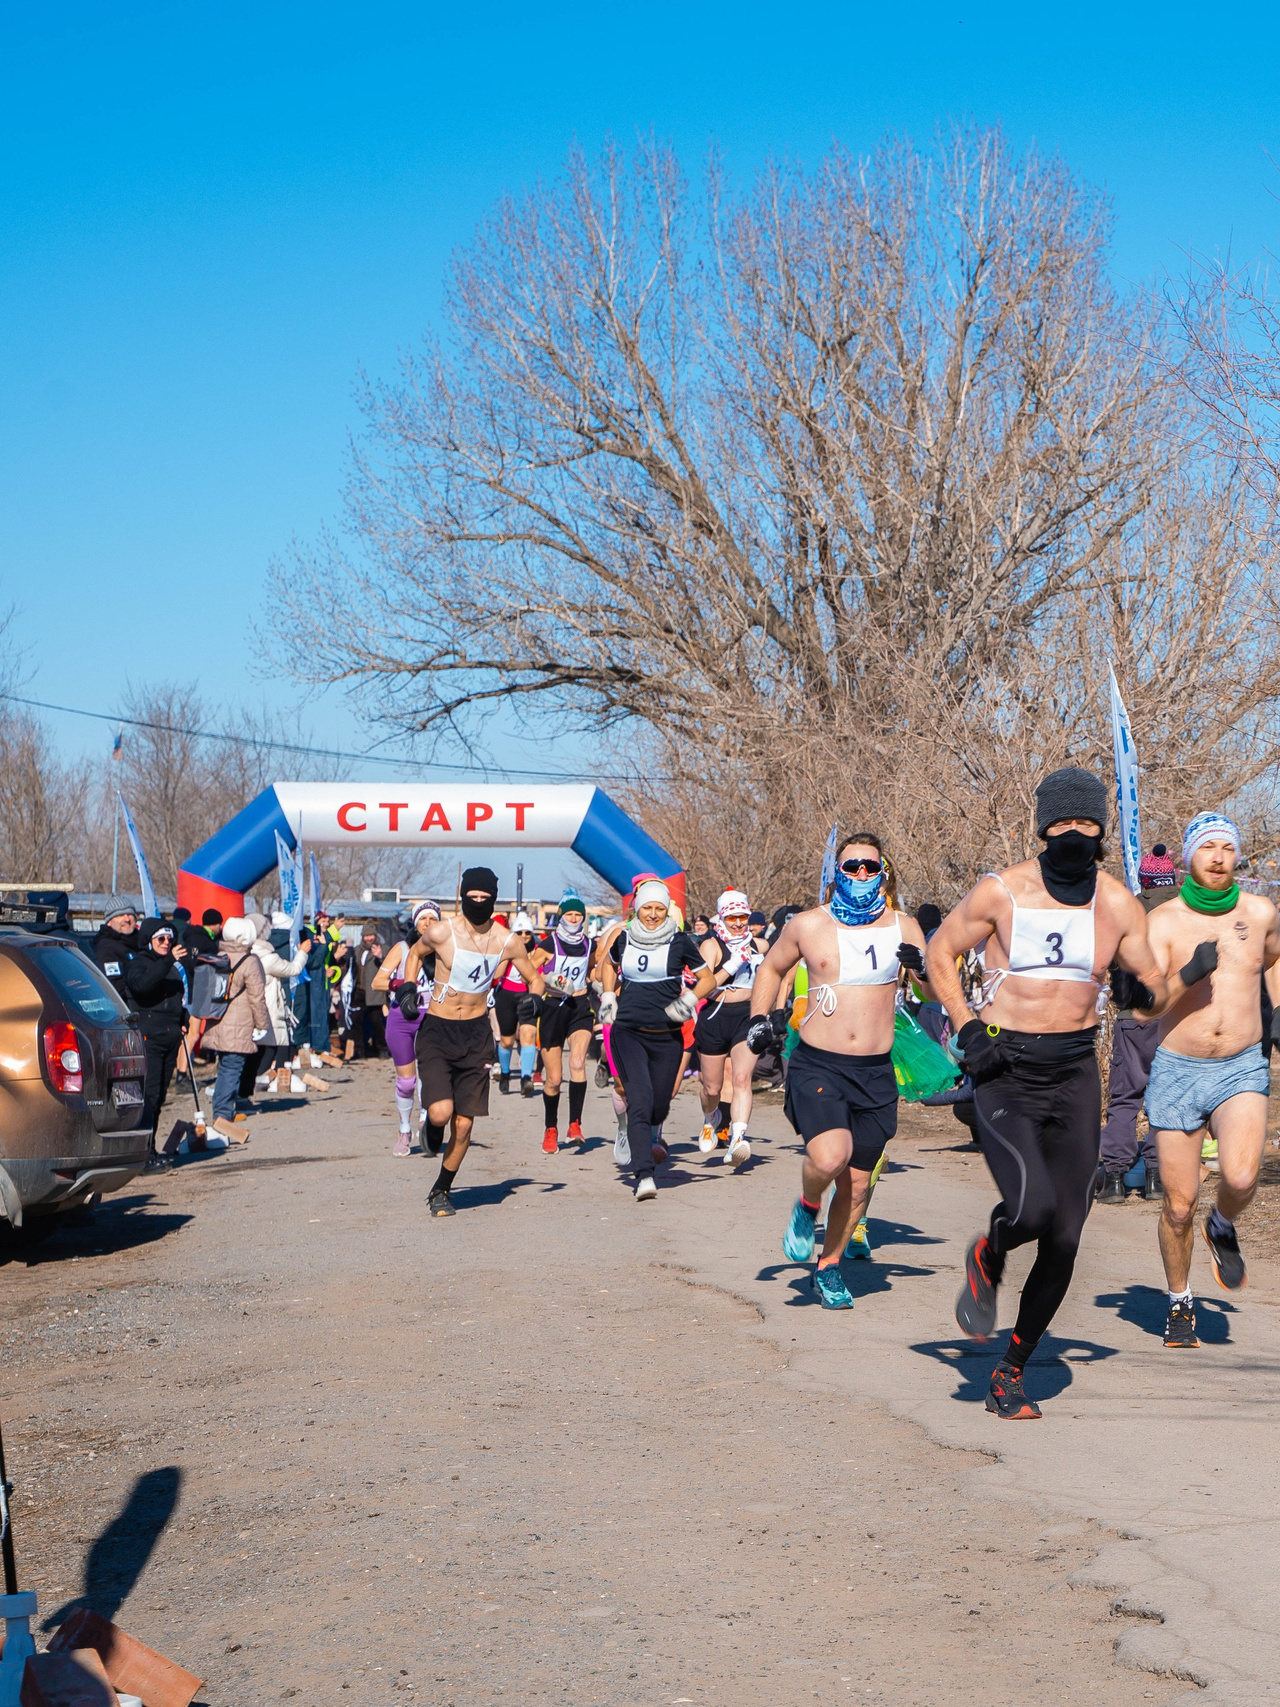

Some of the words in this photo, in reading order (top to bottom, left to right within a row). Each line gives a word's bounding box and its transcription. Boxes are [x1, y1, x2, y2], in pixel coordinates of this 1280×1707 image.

[337, 802, 534, 832] СТАРТ
[865, 945, 877, 970] 1
[1045, 932, 1064, 965] 3
[468, 965, 481, 983] 4
[563, 966, 580, 981] 19
[637, 954, 649, 973] 9
